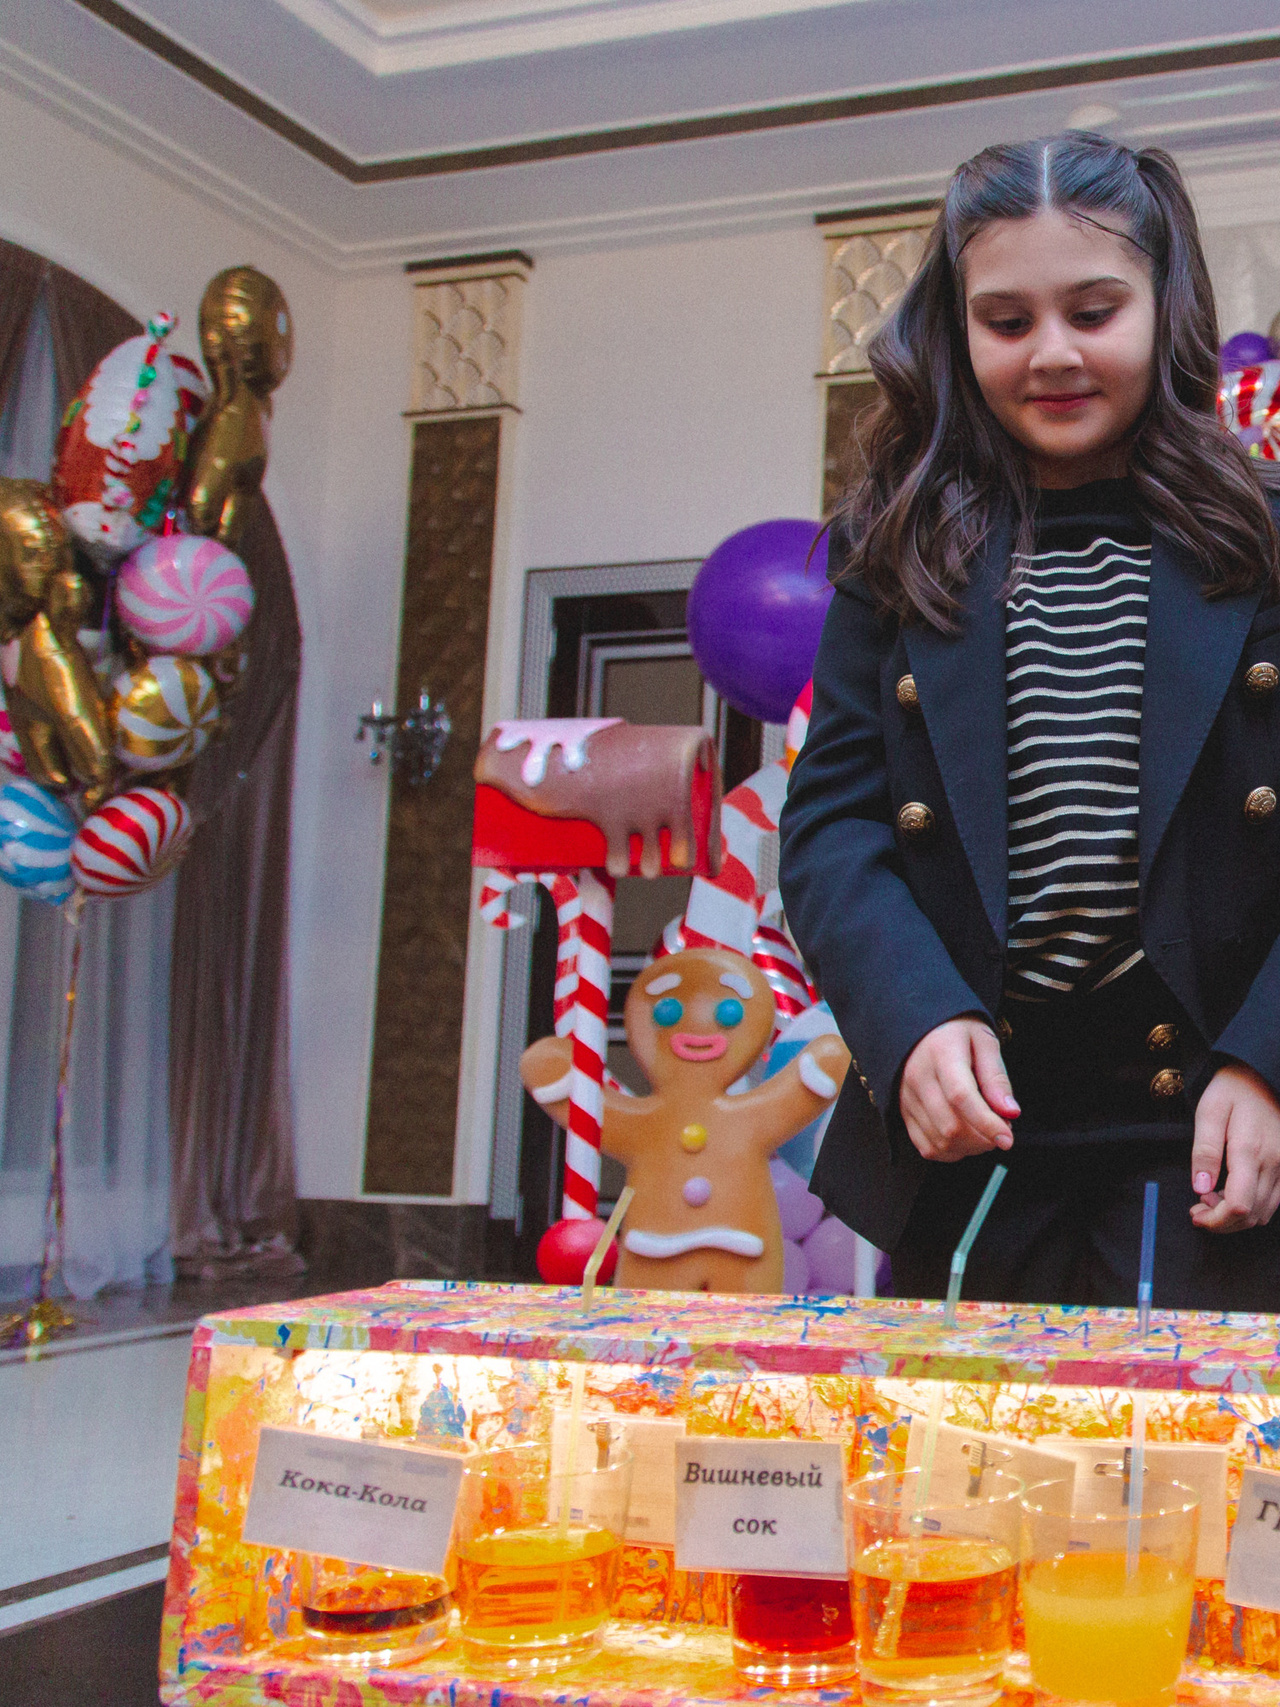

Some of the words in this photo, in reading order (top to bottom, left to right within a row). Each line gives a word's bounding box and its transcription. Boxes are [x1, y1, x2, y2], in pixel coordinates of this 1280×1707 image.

[684, 1462, 824, 1488] Вишневый
[278, 1468, 428, 1514] Кока-Кола
[732, 1518, 778, 1536] сок
